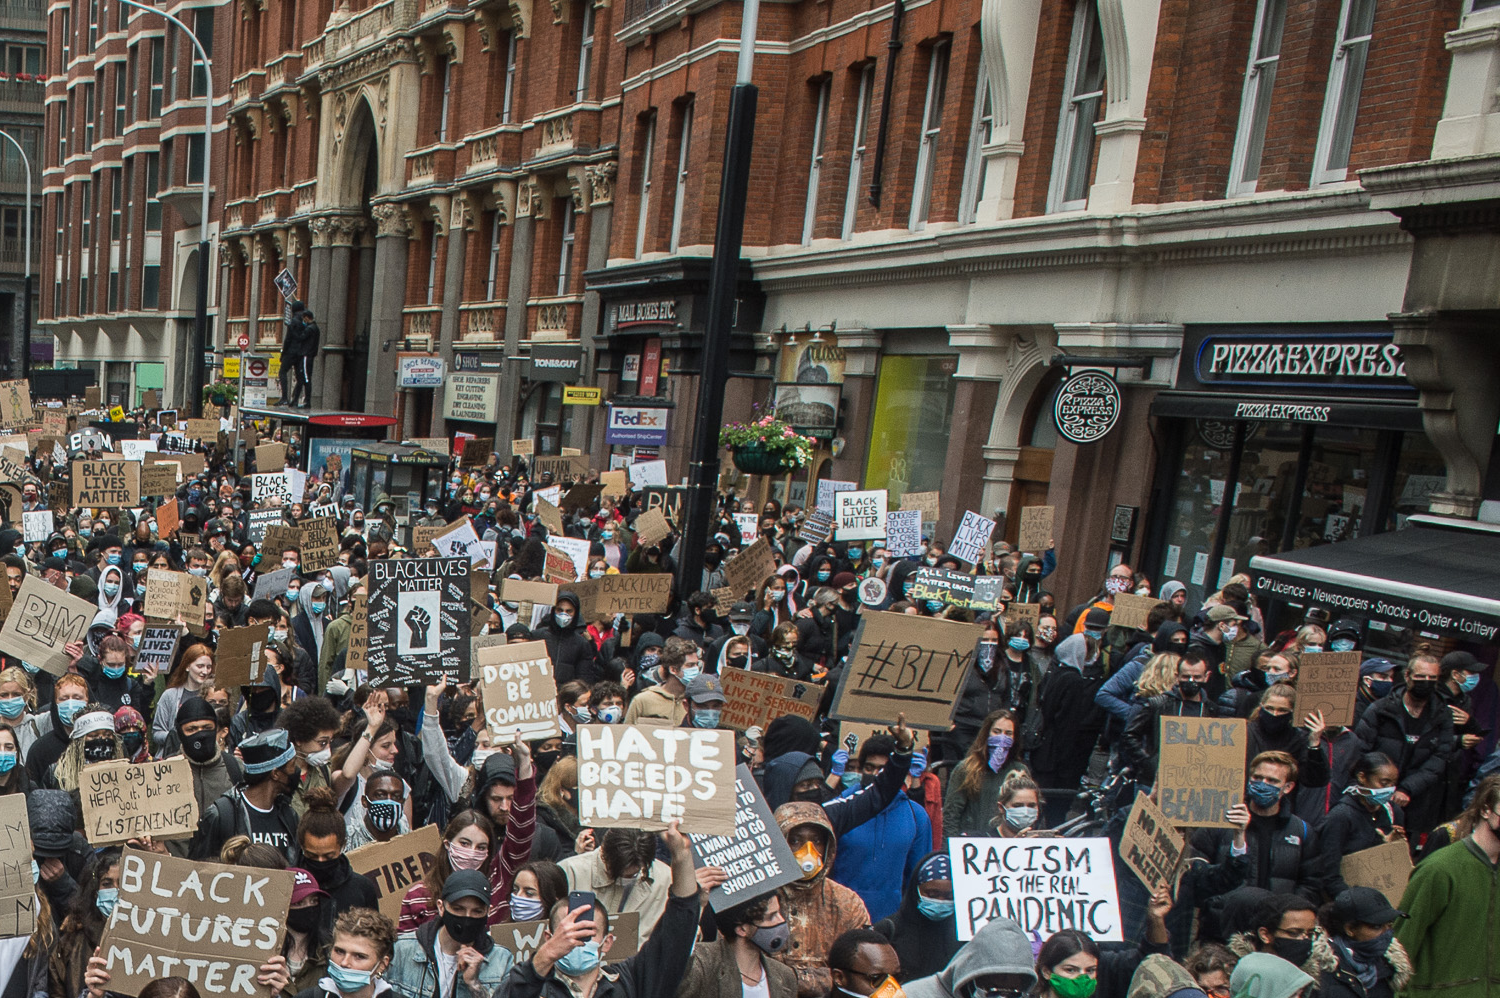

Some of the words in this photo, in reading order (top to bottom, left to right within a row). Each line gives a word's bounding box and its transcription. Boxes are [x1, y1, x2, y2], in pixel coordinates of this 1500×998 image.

[618, 305, 637, 322] MAIL
[637, 302, 659, 321] BOXES
[659, 301, 676, 320] ETC.
[404, 359, 420, 370] SHOE
[462, 354, 478, 368] SHOE
[534, 358, 578, 369] TONI&GUY
[452, 376, 464, 384] SHOE
[457, 393, 483, 402] ENGRAVING
[462, 403, 485, 411] CLEANING
[1072, 396, 1104, 406] PIZZA
[456, 411, 486, 420] LAUNDERERS
[614, 410, 658, 426] FedEx
[1062, 405, 1113, 416] EXPRESS
[636, 432, 663, 440] ShipCenter
[82, 463, 125, 477] BLACK
[84, 477, 126, 489] LIVES
[79, 489, 131, 504] MATTER
[843, 497, 877, 507] BLACK
[843, 506, 878, 517] LIVES
[888, 510, 918, 519] CHOOSE
[888, 519, 898, 527] TO
[888, 526, 919, 535] CHOOSE
[965, 511, 991, 533] BLACK
[888, 534, 899, 542] TO
[900, 533, 918, 542] CARE
[958, 526, 987, 549] LIVES
[375, 561, 424, 580] BLACK
[426, 560, 468, 578] LIVES
[398, 578, 443, 592] MATTER
[603, 576, 642, 595] BLACK
[642, 574, 671, 592] LIVES
[610, 593, 653, 611] MATTER
[1257, 576, 1272, 590] Off
[1272, 579, 1306, 599] Licence
[1313, 587, 1369, 611] Newspapers
[1375, 600, 1411, 620] Snacks
[1418, 609, 1452, 629] Oyster
[1459, 617, 1498, 640] Lottery
[16, 594, 86, 656] BLM
[146, 629, 178, 639] BLACK
[142, 640, 174, 651] LIVES
[138, 652, 171, 664] MATTER
[858, 641, 977, 695] #BLM
[484, 657, 551, 687] DON'T
[507, 675, 533, 702] BE
[724, 671, 746, 683] ARE
[750, 677, 785, 695] THEIR
[722, 700, 763, 718] WORTH
[724, 685, 760, 703] LIVES
[764, 695, 814, 717] SERIOUSLY
[1164, 720, 1239, 748] BLACK
[581, 726, 724, 771] HATE
[124, 766, 146, 787] say
[153, 763, 173, 781] you
[580, 760, 719, 802] BREEDS
[89, 787, 123, 808] HEAR
[146, 783, 162, 799] but
[166, 783, 181, 795] are
[580, 789, 687, 827] HATE
[703, 839, 757, 867] FORWARD
[754, 833, 772, 848] TO
[963, 843, 1091, 877] RACISM
[121, 854, 271, 907] BLACK
[362, 851, 437, 899] TIRED
[721, 868, 766, 896] SHOULD
[764, 861, 783, 879] BE
[988, 876, 1009, 894] IS
[1018, 875, 1047, 894] THE
[1048, 876, 1088, 897] REAL
[109, 898, 280, 950] FUTURES
[969, 895, 1112, 936] PANDEMIC
[106, 944, 258, 996] MATTER
